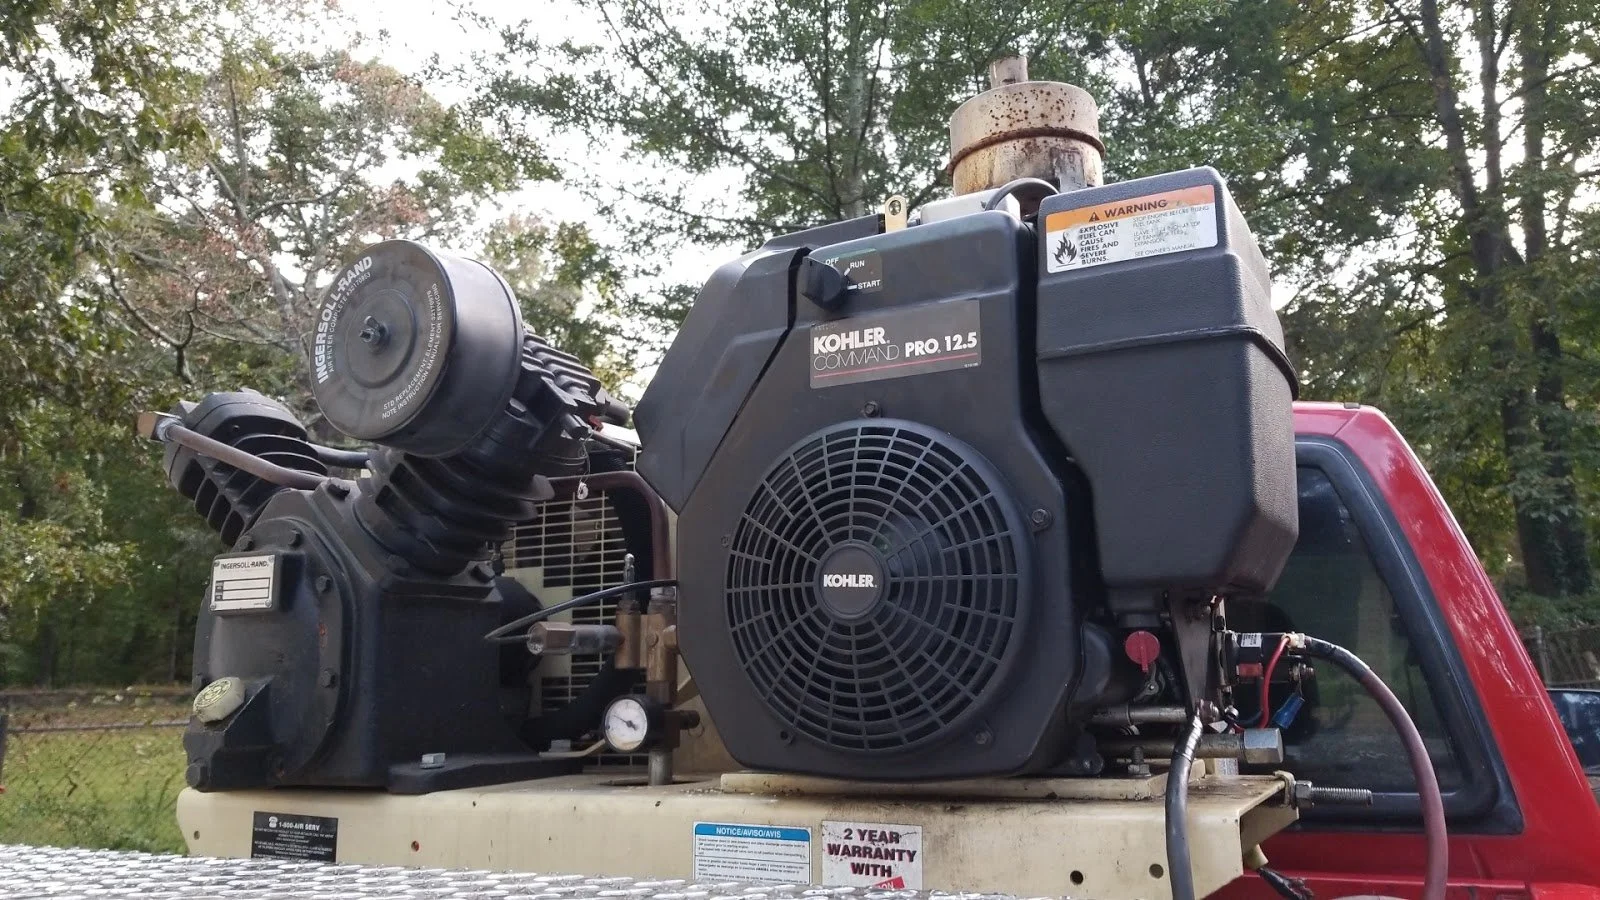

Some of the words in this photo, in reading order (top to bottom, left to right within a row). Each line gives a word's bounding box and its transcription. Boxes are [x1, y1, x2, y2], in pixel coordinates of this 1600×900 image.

[1104, 200, 1168, 218] WARNING
[1079, 222, 1119, 234] EXPLOSIVE
[1080, 232, 1097, 240] FUEL
[1098, 229, 1116, 237] CAN
[1080, 237, 1104, 247] CAUSE
[1080, 244, 1100, 252] FIRES
[1102, 240, 1119, 249] AND
[1080, 249, 1107, 259] SEVERE
[825, 257, 839, 266] OFF
[849, 260, 865, 270] RUN
[857, 279, 881, 290] START
[315, 256, 373, 385] INGERSOLL-RAND
[329, 296, 348, 333] COMPLETE
[326, 334, 334, 360] FILTER
[813, 344, 900, 371] COMMAND
[944, 332, 978, 352] 12.5
[327, 360, 335, 373] AIR
[383, 399, 395, 410] STD
[395, 359, 428, 402] REPLACEMENT
[425, 323, 436, 357] ELEMENT
[381, 406, 398, 420] NOTE
[397, 370, 429, 410] INSTRUCTION
[427, 340, 440, 370] MANUAL
[305, 823, 320, 831] SERV
[716, 827, 782, 839] NOTICE/AVISO/AVIS
[843, 828, 853, 840] 2
[857, 828, 900, 844] YEAR
[827, 843, 917, 863] WARRANTY
[851, 862, 892, 878] WITH
